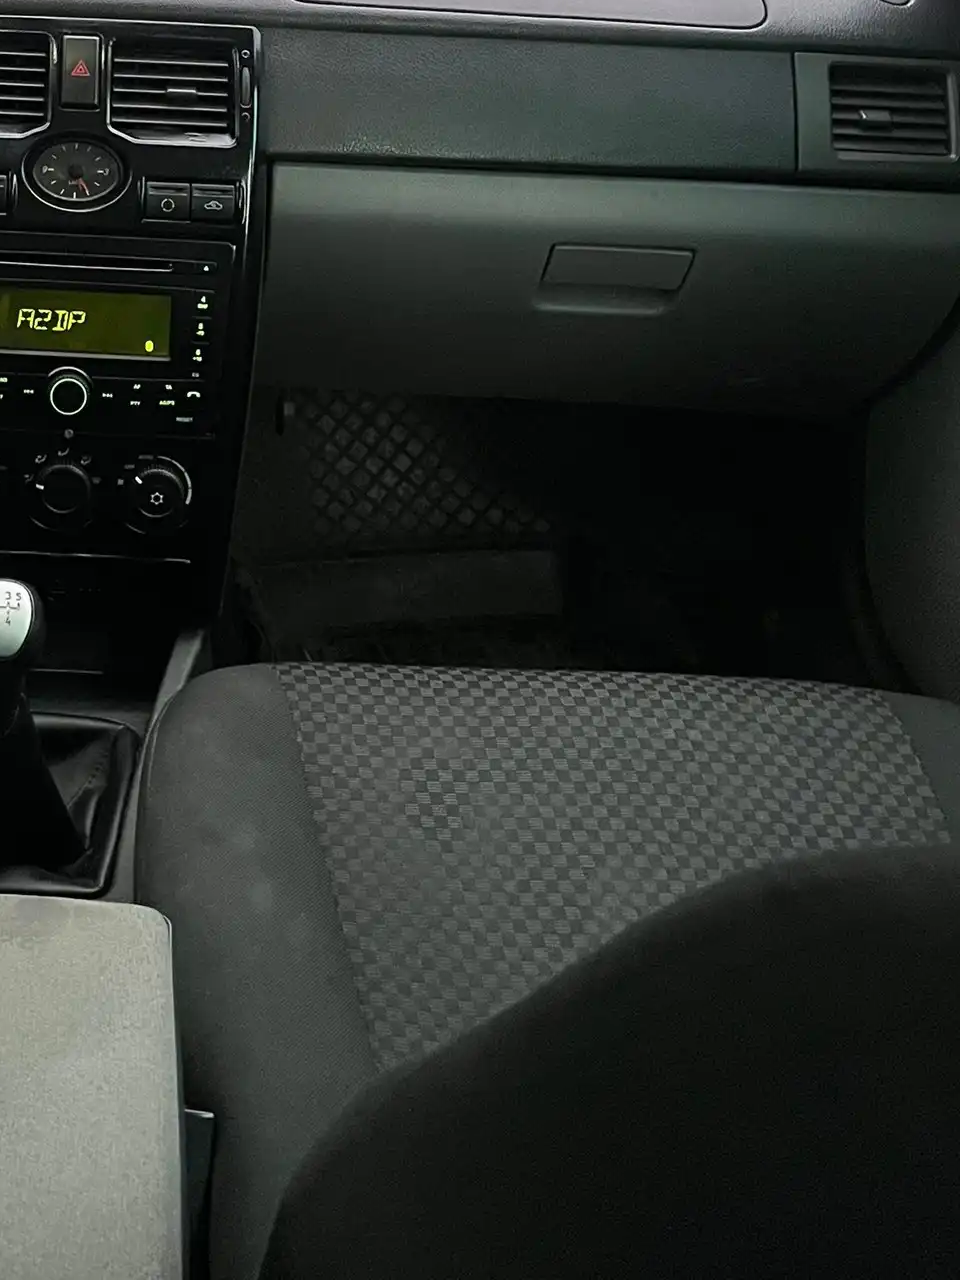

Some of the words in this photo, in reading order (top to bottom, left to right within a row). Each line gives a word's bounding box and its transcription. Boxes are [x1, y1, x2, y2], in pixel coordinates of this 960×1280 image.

[17, 308, 87, 331] A2DP
[5, 591, 12, 600] 3
[5, 616, 11, 626] 4
